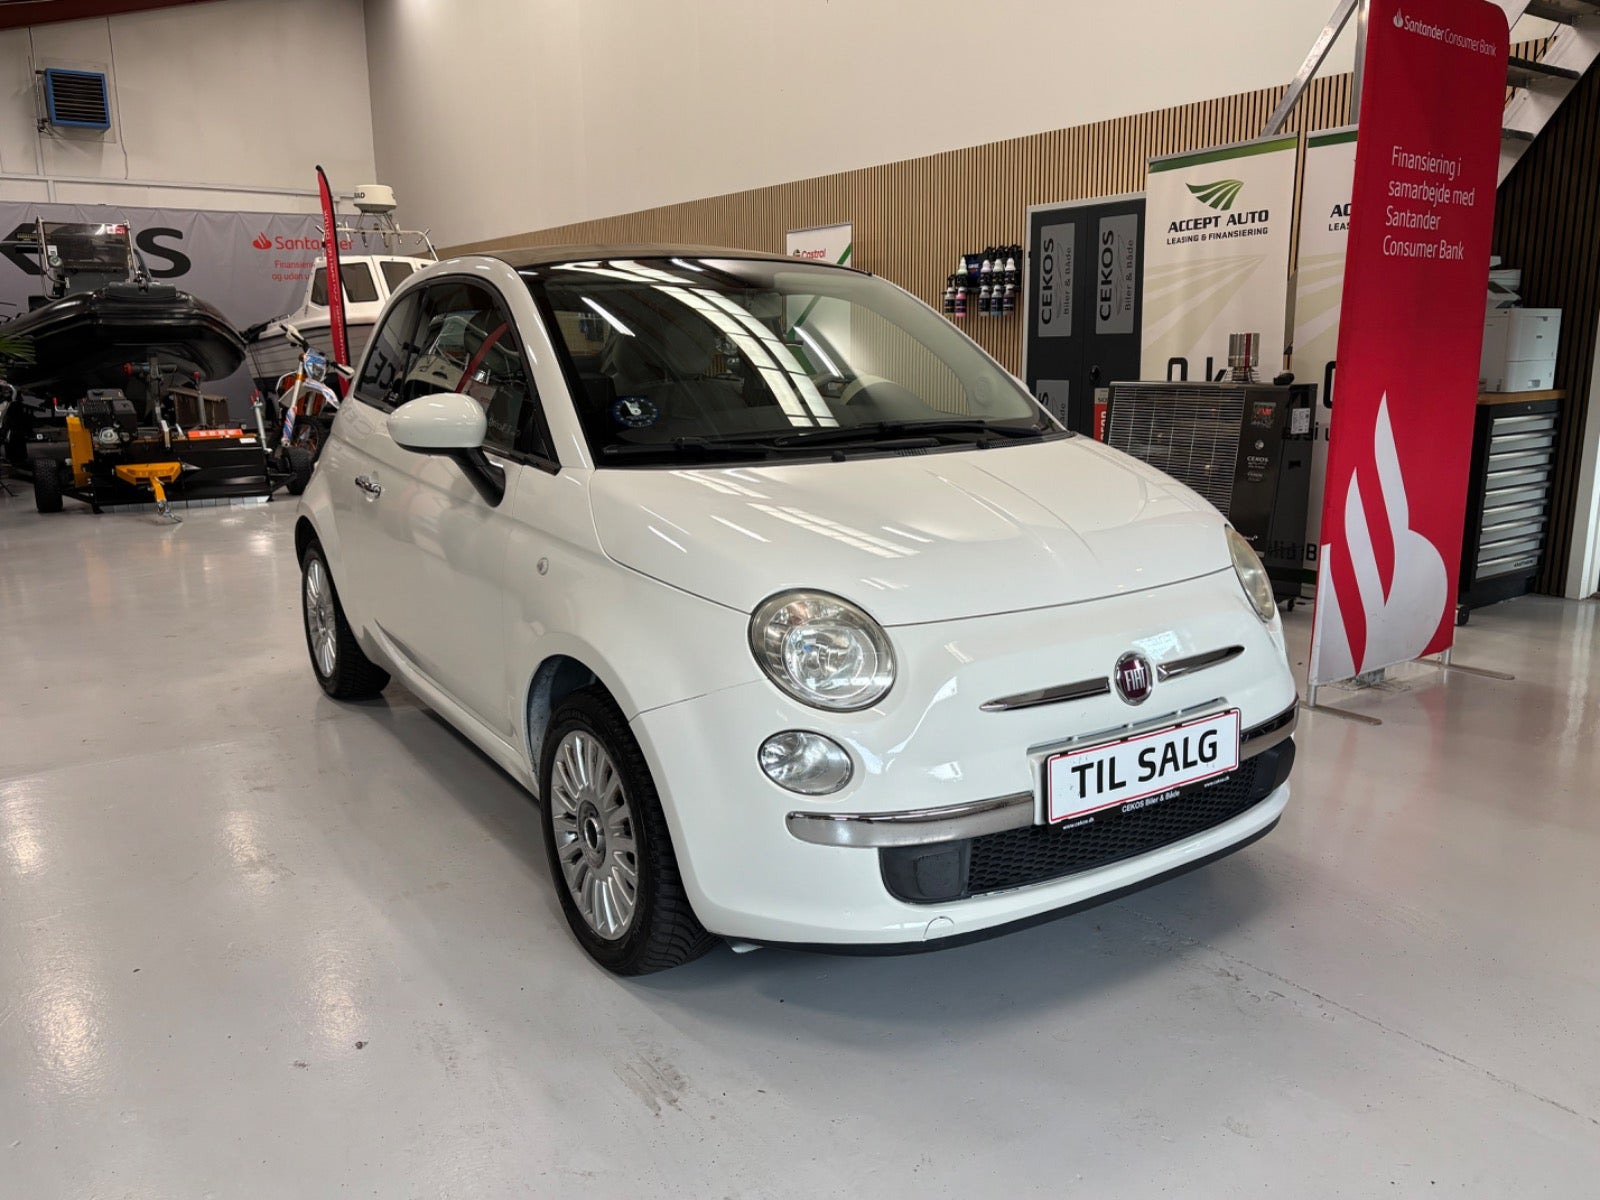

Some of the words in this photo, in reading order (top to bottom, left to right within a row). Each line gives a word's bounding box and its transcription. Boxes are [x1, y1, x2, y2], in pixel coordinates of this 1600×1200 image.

[1404, 15, 1444, 41] Santander
[1444, 28, 1480, 52] Consumer
[1480, 39, 1497, 56] Bank
[1391, 145, 1456, 181] Finansiering
[1457, 156, 1462, 177] i
[1388, 180, 1450, 208] samarbejde
[1452, 187, 1475, 206] med
[1168, 215, 1221, 234] ACCEPT
[1226, 209, 1269, 227] AUTO
[1385, 205, 1441, 230] Santander
[1166, 234, 1199, 245] LEASING
[1208, 226, 1268, 241] FINANSIERING
[1383, 235, 1438, 258] Consumer
[1439, 239, 1464, 260] Bank
[802, 248, 827, 259] Castrol
[1041, 238, 1054, 325] CEKOS
[1100, 230, 1114, 321] CEKOS
[1124, 285, 1133, 311] Biler
[1124, 668, 1146, 692] FIAT
[1071, 756, 1126, 799] TIL
[1138, 729, 1218, 783] SALG
[1121, 800, 1145, 813] CEKOS
